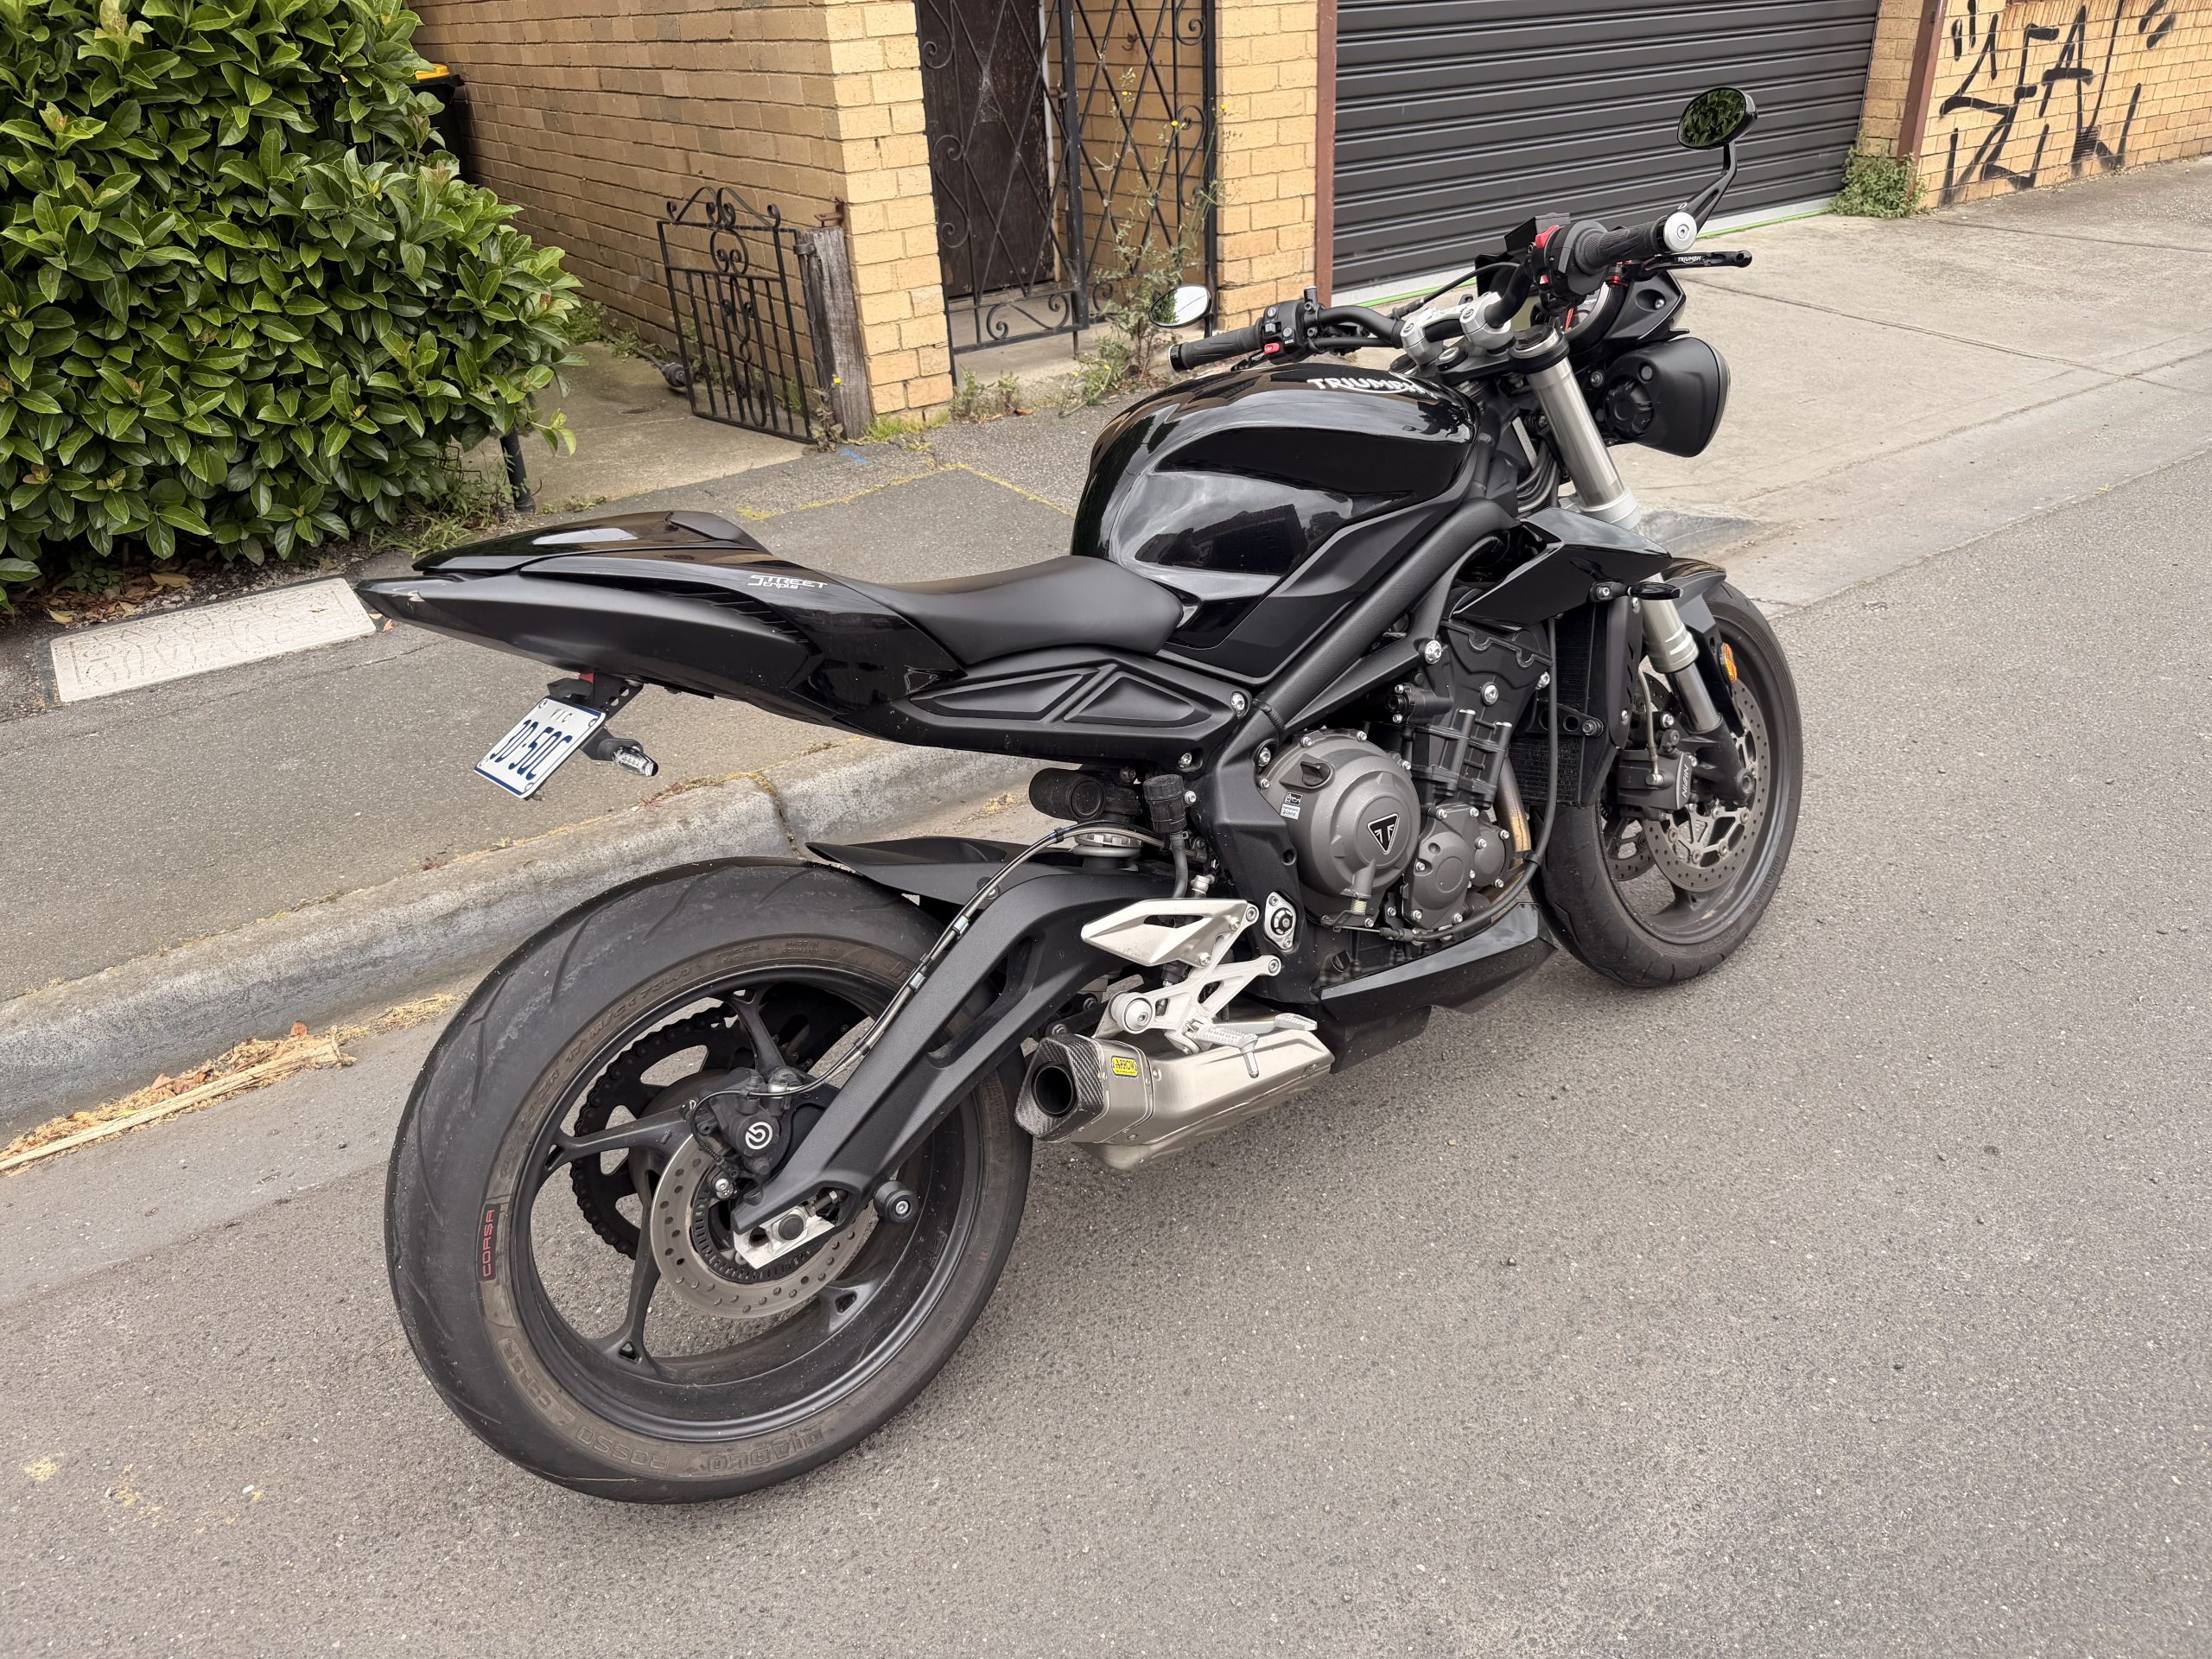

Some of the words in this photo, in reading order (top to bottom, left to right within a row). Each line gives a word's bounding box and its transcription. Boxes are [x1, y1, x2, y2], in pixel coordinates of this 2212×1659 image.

[1306, 378, 1426, 395] TRIUMPH
[747, 575, 829, 588] STREET
[550, 708, 573, 723] VIC
[482, 1208, 496, 1278] CORSA
[499, 1339, 552, 1410] CORSA
[575, 1426, 670, 1470] ROSSO
